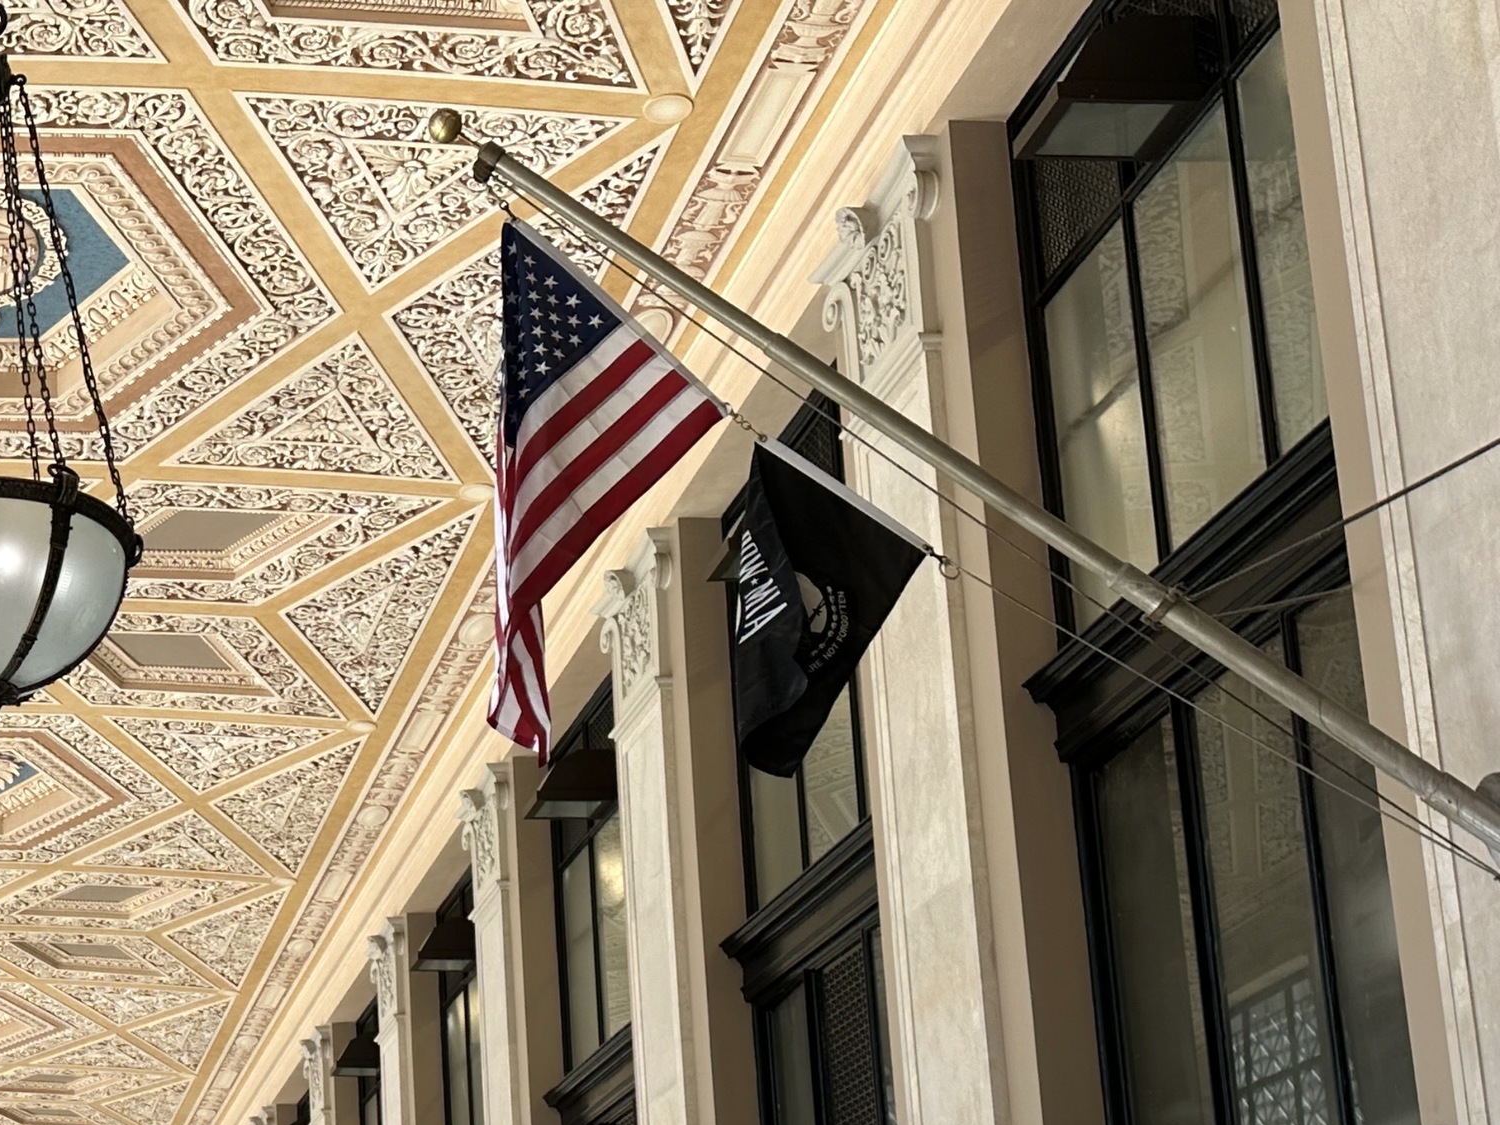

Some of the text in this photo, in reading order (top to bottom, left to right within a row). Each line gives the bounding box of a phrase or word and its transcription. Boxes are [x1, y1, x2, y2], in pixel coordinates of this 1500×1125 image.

[738, 577, 788, 645] MIA
[822, 642, 839, 660] NOT
[836, 591, 849, 643] FORGOTTEN
